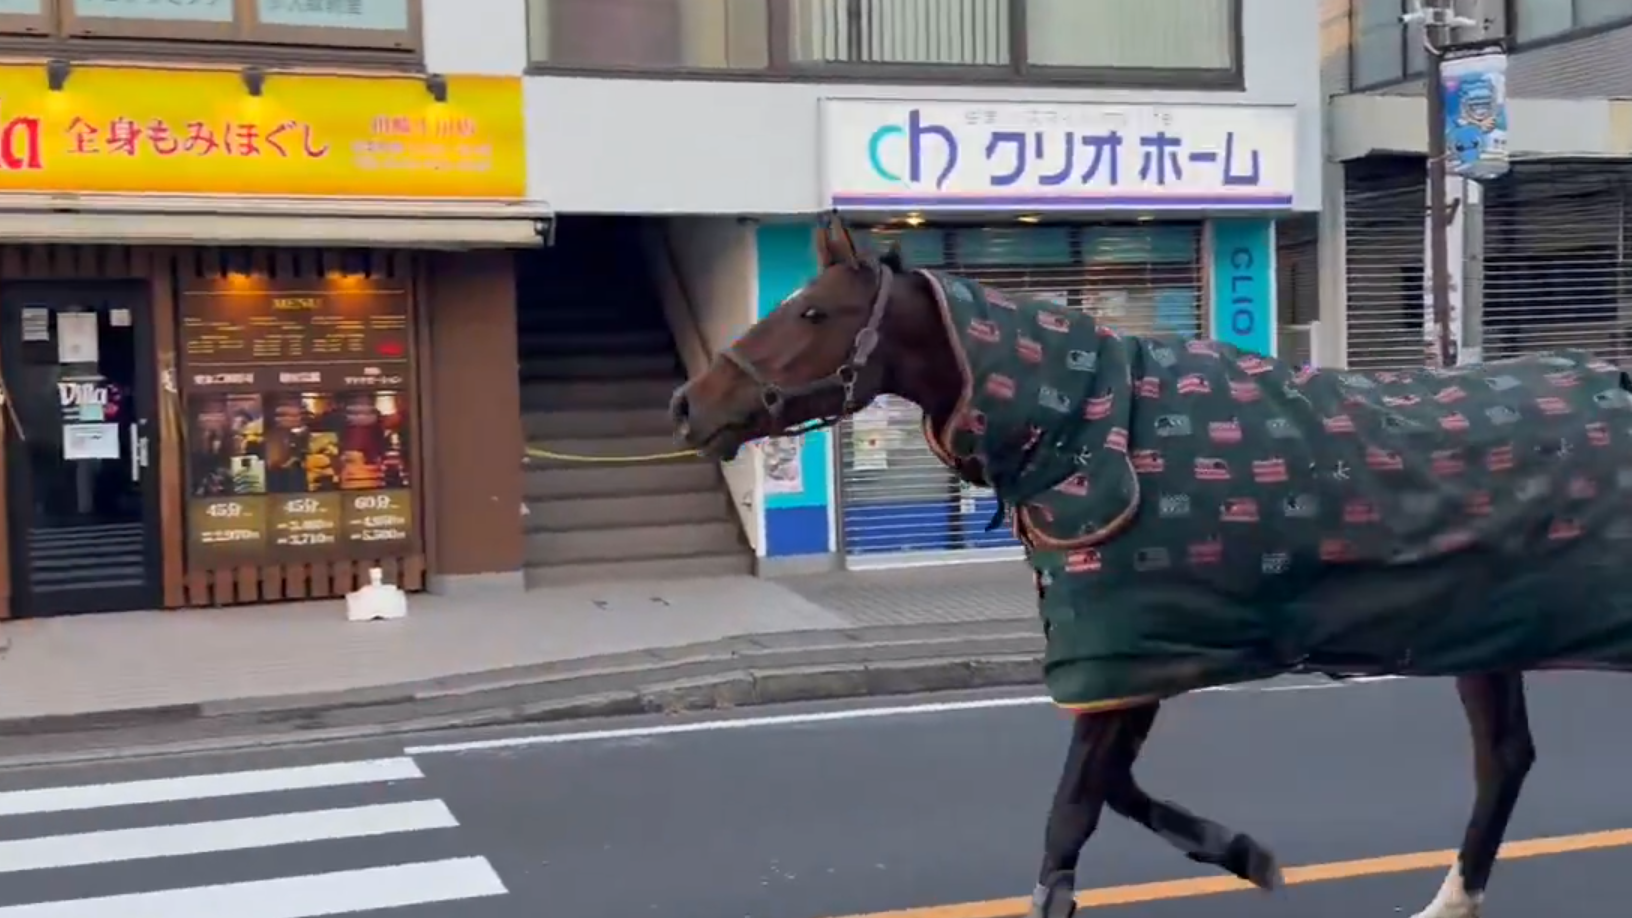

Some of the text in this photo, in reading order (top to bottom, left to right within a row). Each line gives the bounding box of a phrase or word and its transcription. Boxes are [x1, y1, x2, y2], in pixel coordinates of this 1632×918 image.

[66, 115, 329, 158] 全身もみほぐし
[273, 298, 320, 310] MENU
[1230, 247, 1254, 336] CLIO
